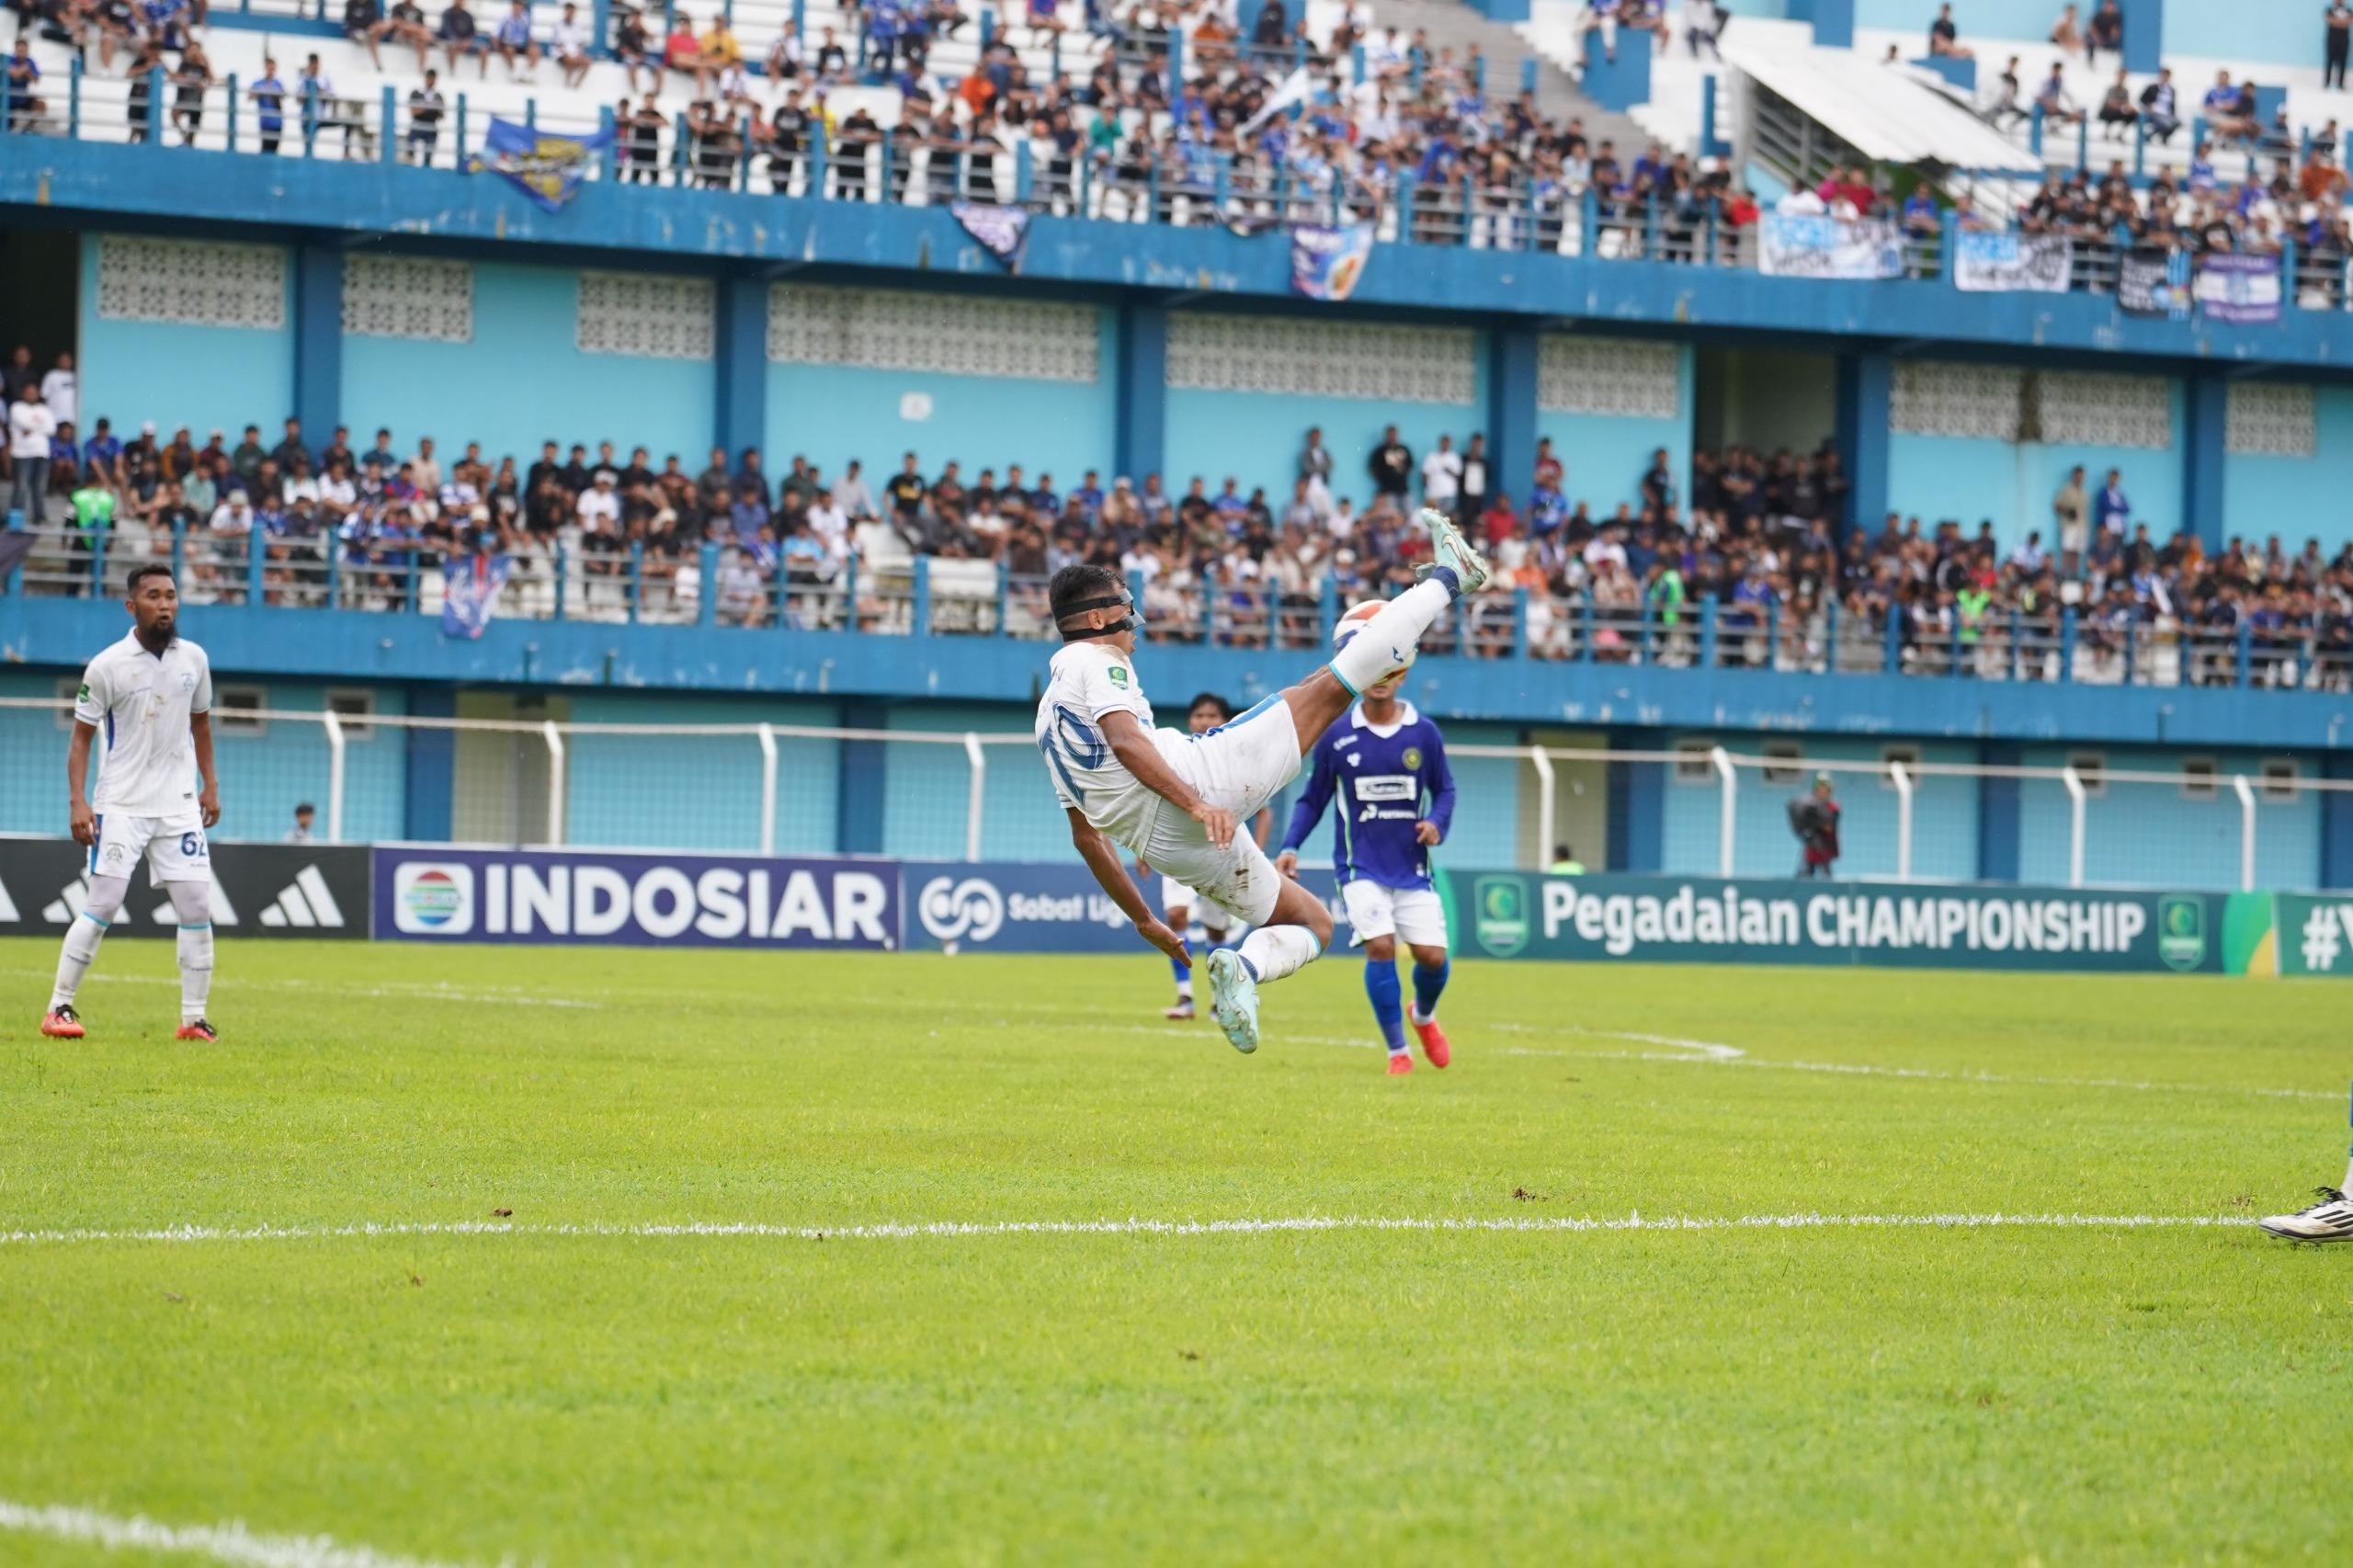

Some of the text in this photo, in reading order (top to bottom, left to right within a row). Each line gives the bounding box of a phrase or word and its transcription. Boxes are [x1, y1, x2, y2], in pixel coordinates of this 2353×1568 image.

[485, 864, 887, 940] INDOSIAR
[1541, 881, 2145, 956] Pegadaian CHAMPIONSHIP
